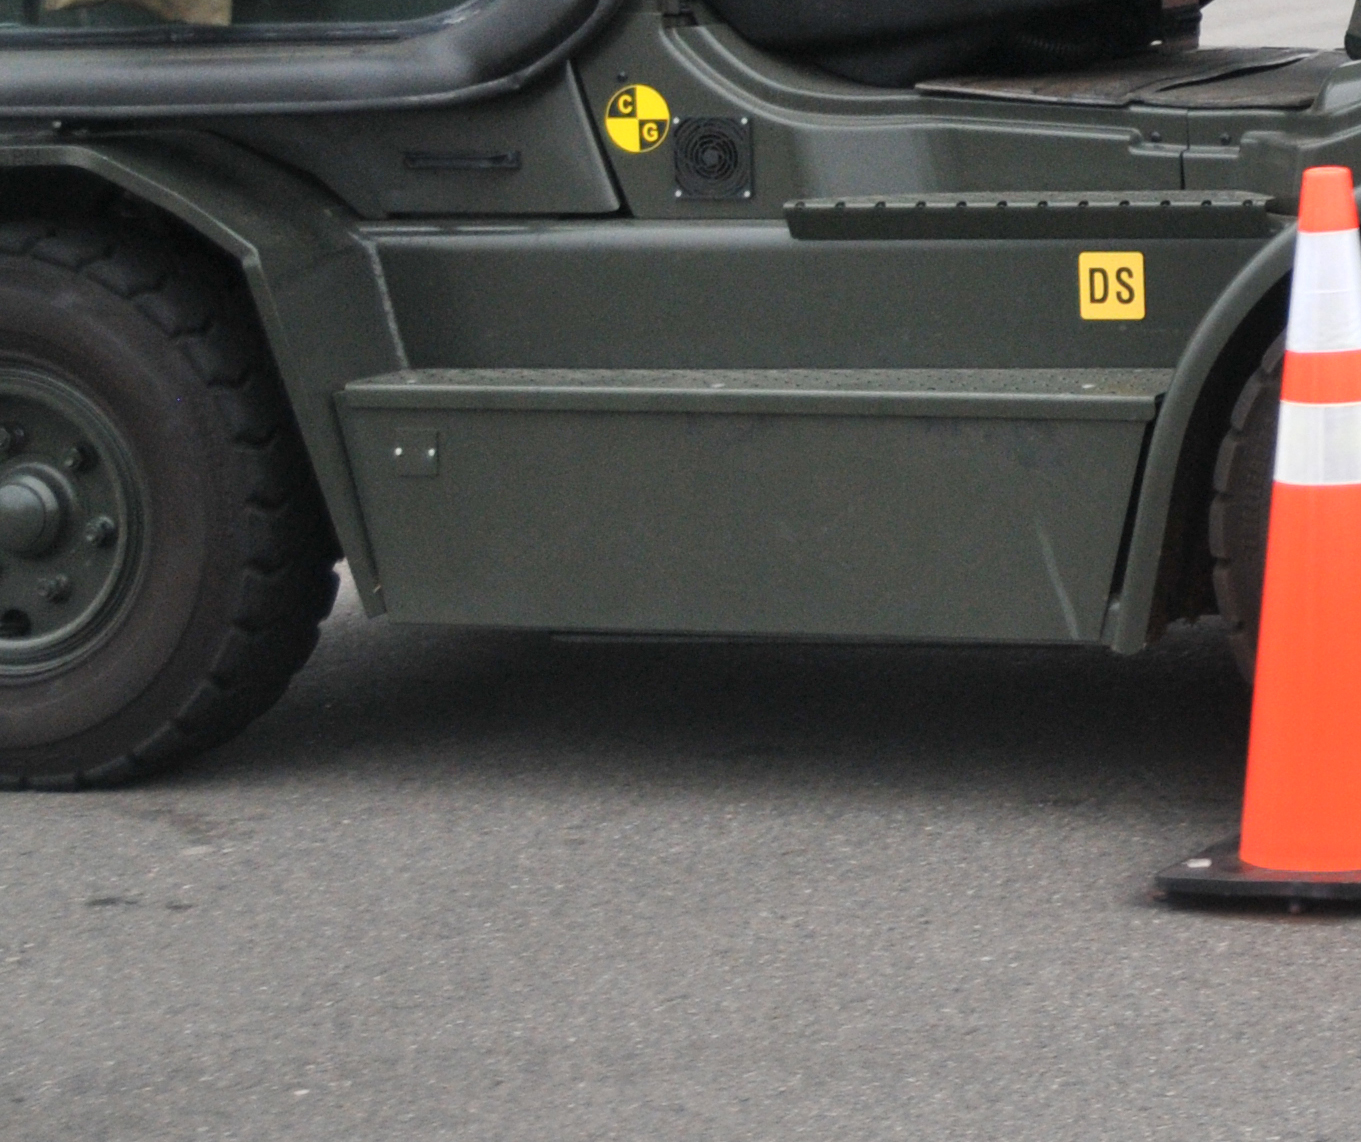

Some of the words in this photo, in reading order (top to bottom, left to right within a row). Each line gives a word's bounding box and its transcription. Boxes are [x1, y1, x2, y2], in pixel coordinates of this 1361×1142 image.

[617, 94, 634, 114] C
[642, 122, 660, 143] G
[1088, 266, 1136, 305] DS
